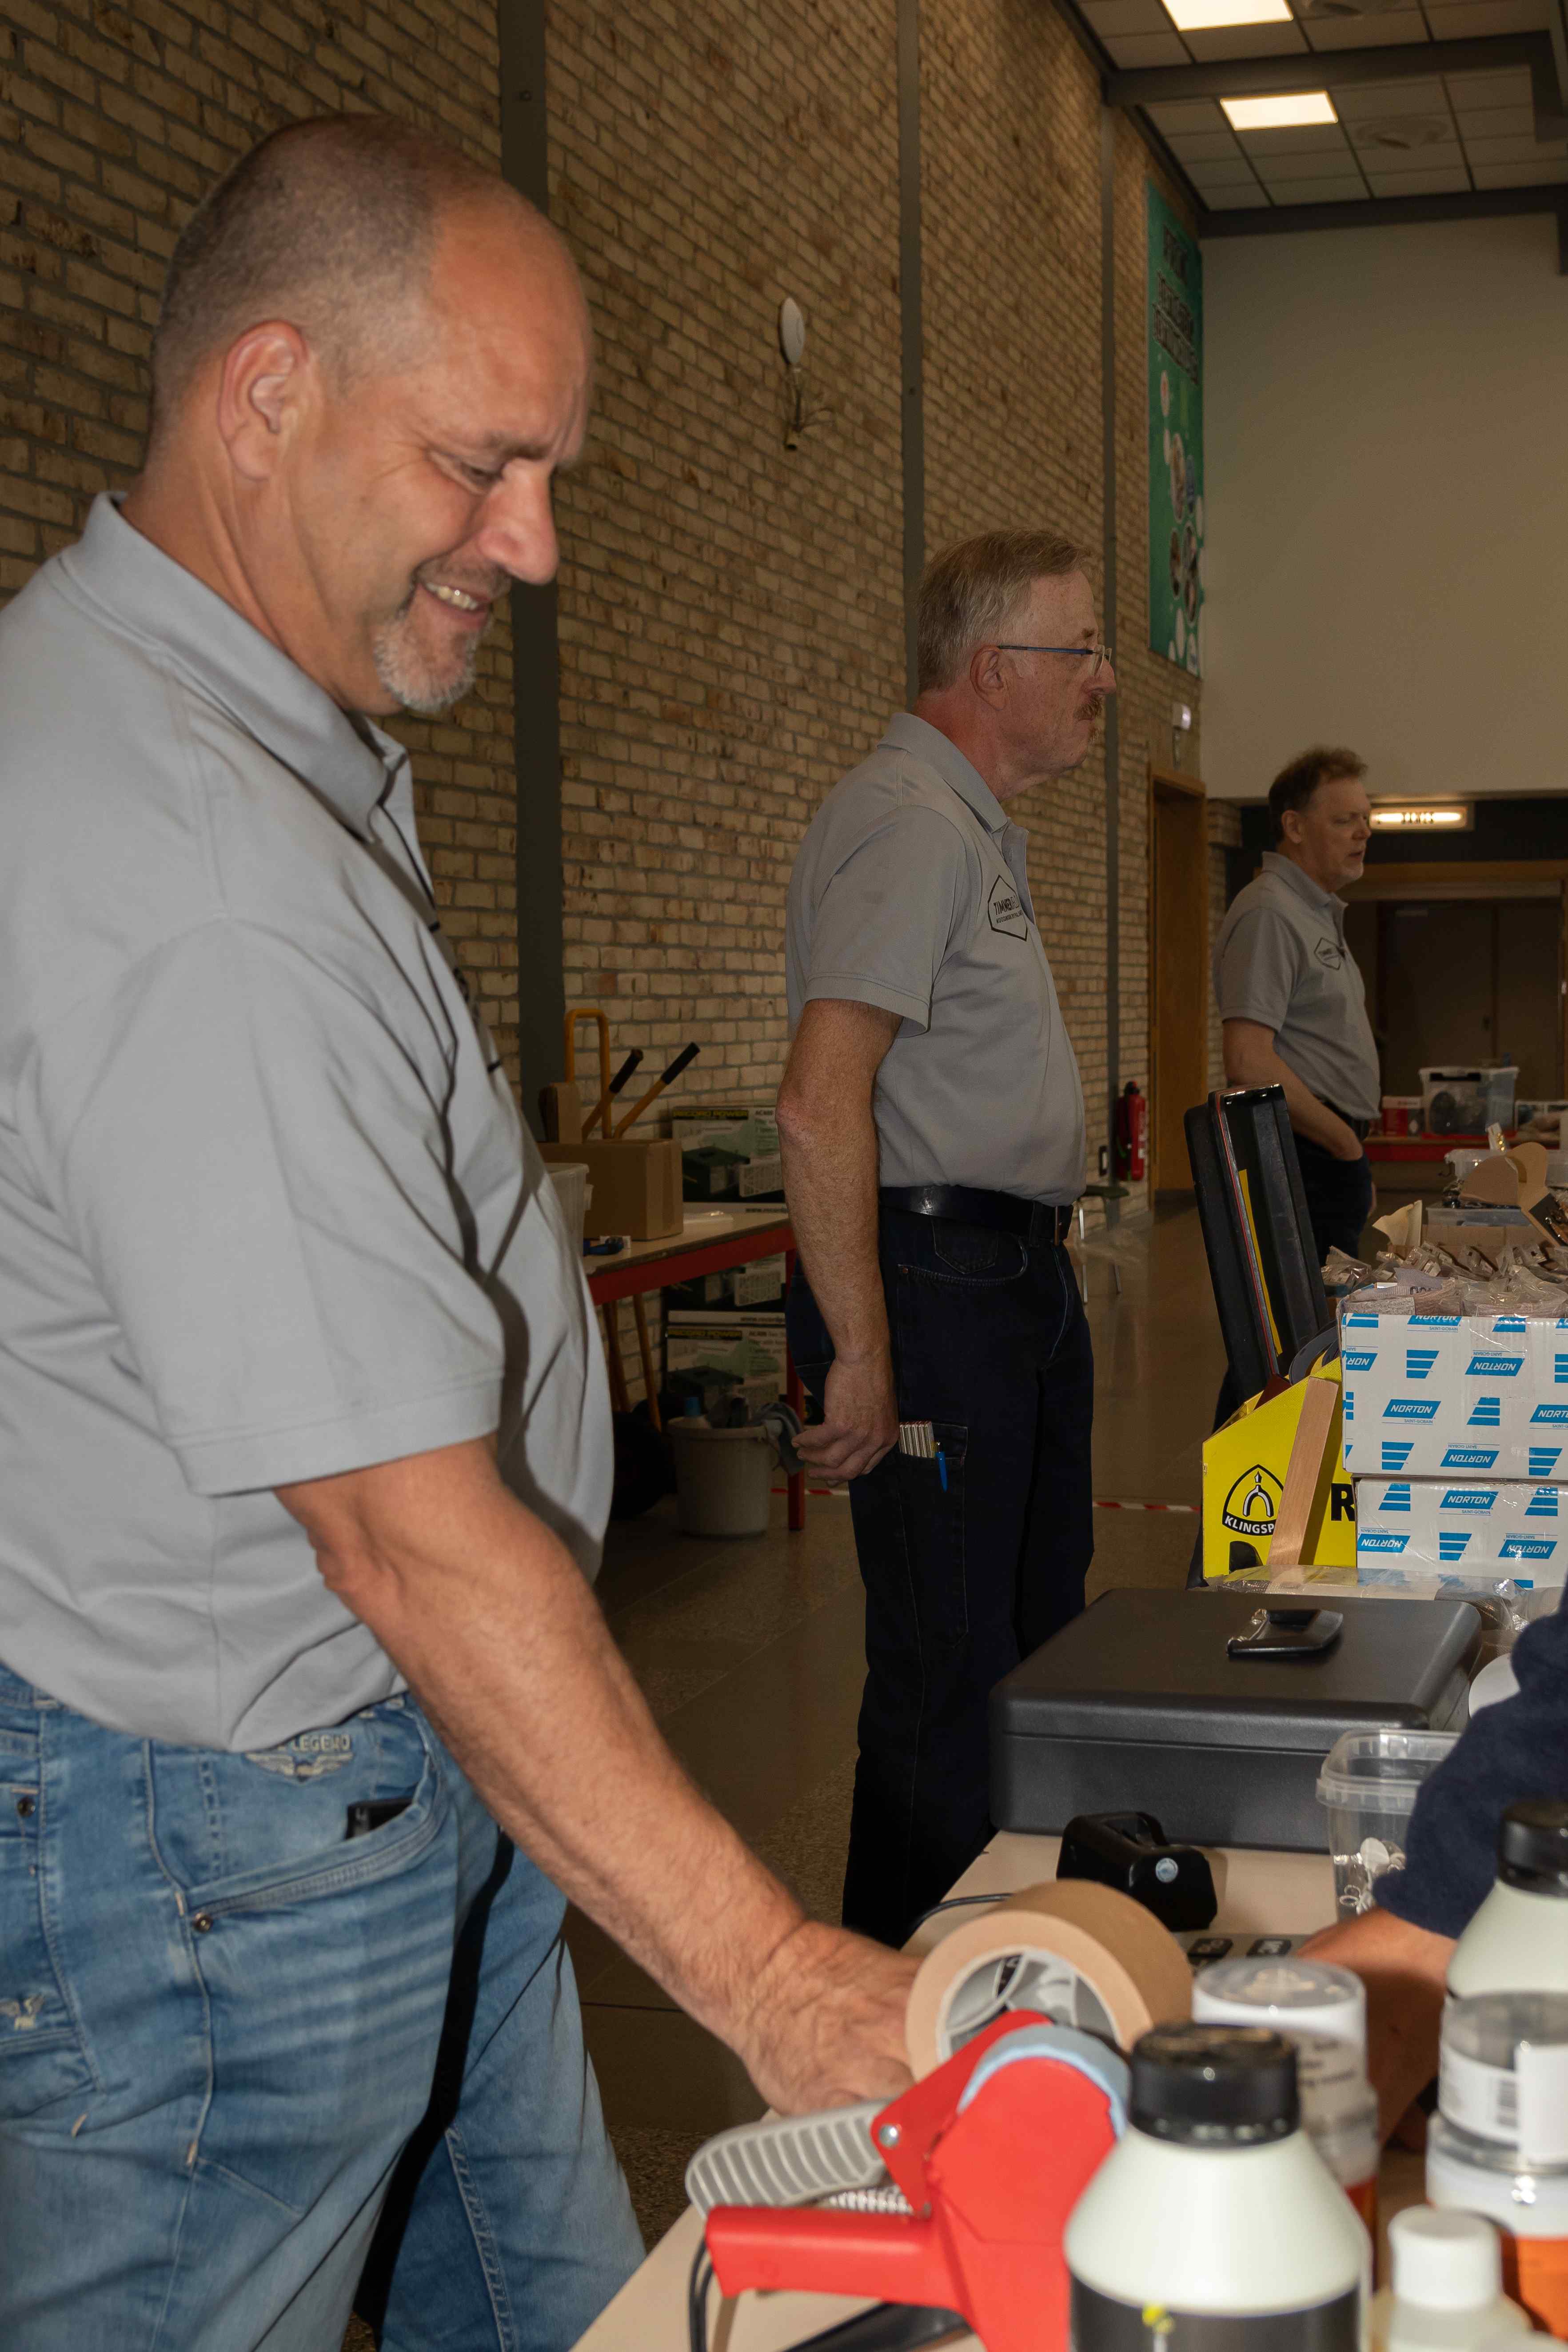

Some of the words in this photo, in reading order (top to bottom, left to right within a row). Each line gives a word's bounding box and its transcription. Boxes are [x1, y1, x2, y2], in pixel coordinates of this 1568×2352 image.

[1474, 1362, 1516, 1371] NORTON
[1391, 1405, 1432, 1414] NORTON
[1448, 1454, 1491, 1463] NORTON
[1448, 1496, 1490, 1504] NORTON
[1225, 1515, 1274, 1534] KLINGSP
[1361, 1539, 1403, 1548] NORTON
[1506, 1545, 1549, 1553] NORTON
